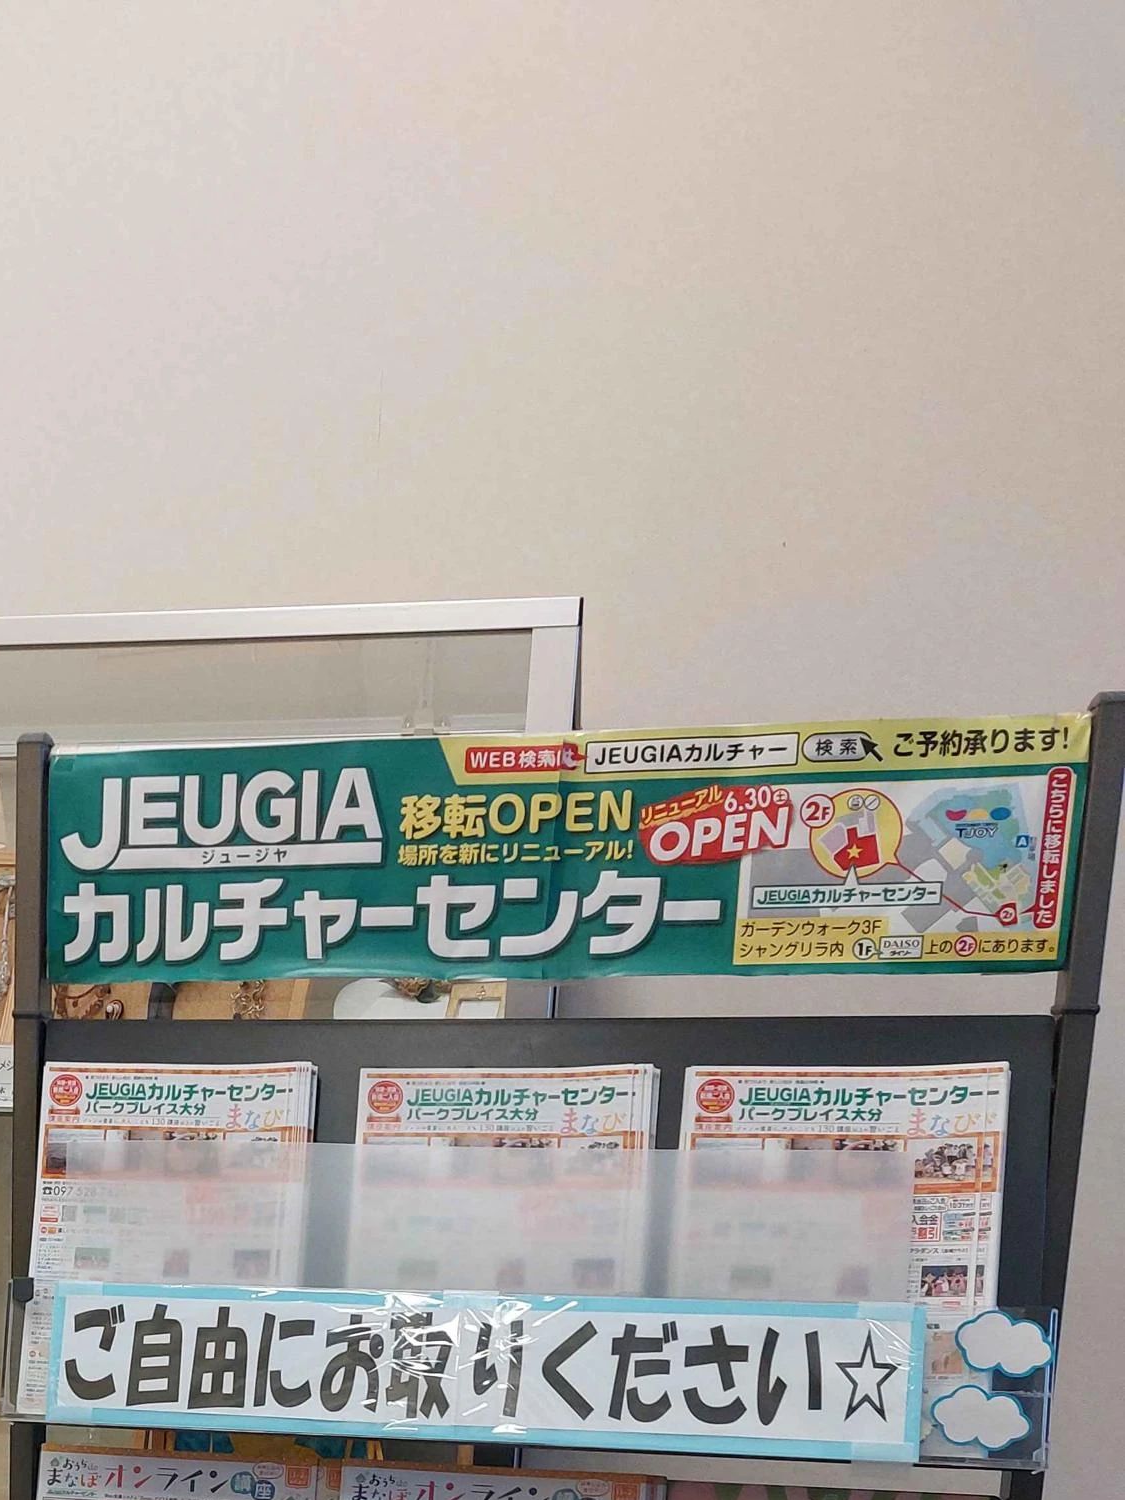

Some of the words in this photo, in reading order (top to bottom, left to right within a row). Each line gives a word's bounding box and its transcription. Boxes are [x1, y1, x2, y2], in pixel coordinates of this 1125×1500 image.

[594, 741, 789, 765] JEUGIAカルチャー
[815, 739, 859, 757] 検索
[893, 726, 1070, 759] ご予約承ります!
[400, 789, 633, 840] 移転OPEN
[640, 785, 722, 824] リニューアル
[805, 801, 831, 822] 2F
[60, 767, 383, 870] JEUGIA
[648, 805, 791, 863] OPEN
[399, 840, 633, 867] 場所を新にリニューアル!
[1036, 772, 1070, 927] こちらに移転しました
[757, 885, 937, 905] JEUGIAカルチャーセンター
[63, 870, 722, 963] カルチャーセンター
[741, 919, 882, 938] ガーデンウォーク3F
[740, 940, 843, 959] シャングリラ内
[856, 942, 873, 957] 1F
[883, 940, 920, 949] DAISO
[85, 1083, 286, 1102] JEUGIAカルチャーセンター
[407, 1086, 628, 1107] JEUGIAカルチャーセンター
[739, 1086, 983, 1107] JEUGIAカルチャーセンター
[85, 1101, 206, 1116] パークプレイス大分
[407, 1108, 539, 1122] パークプレイス大分
[739, 1108, 883, 1122] パークプレイス大分
[63, 1302, 823, 1427] ご自由にお取りください
[104, 1463, 228, 1494] オンライン
